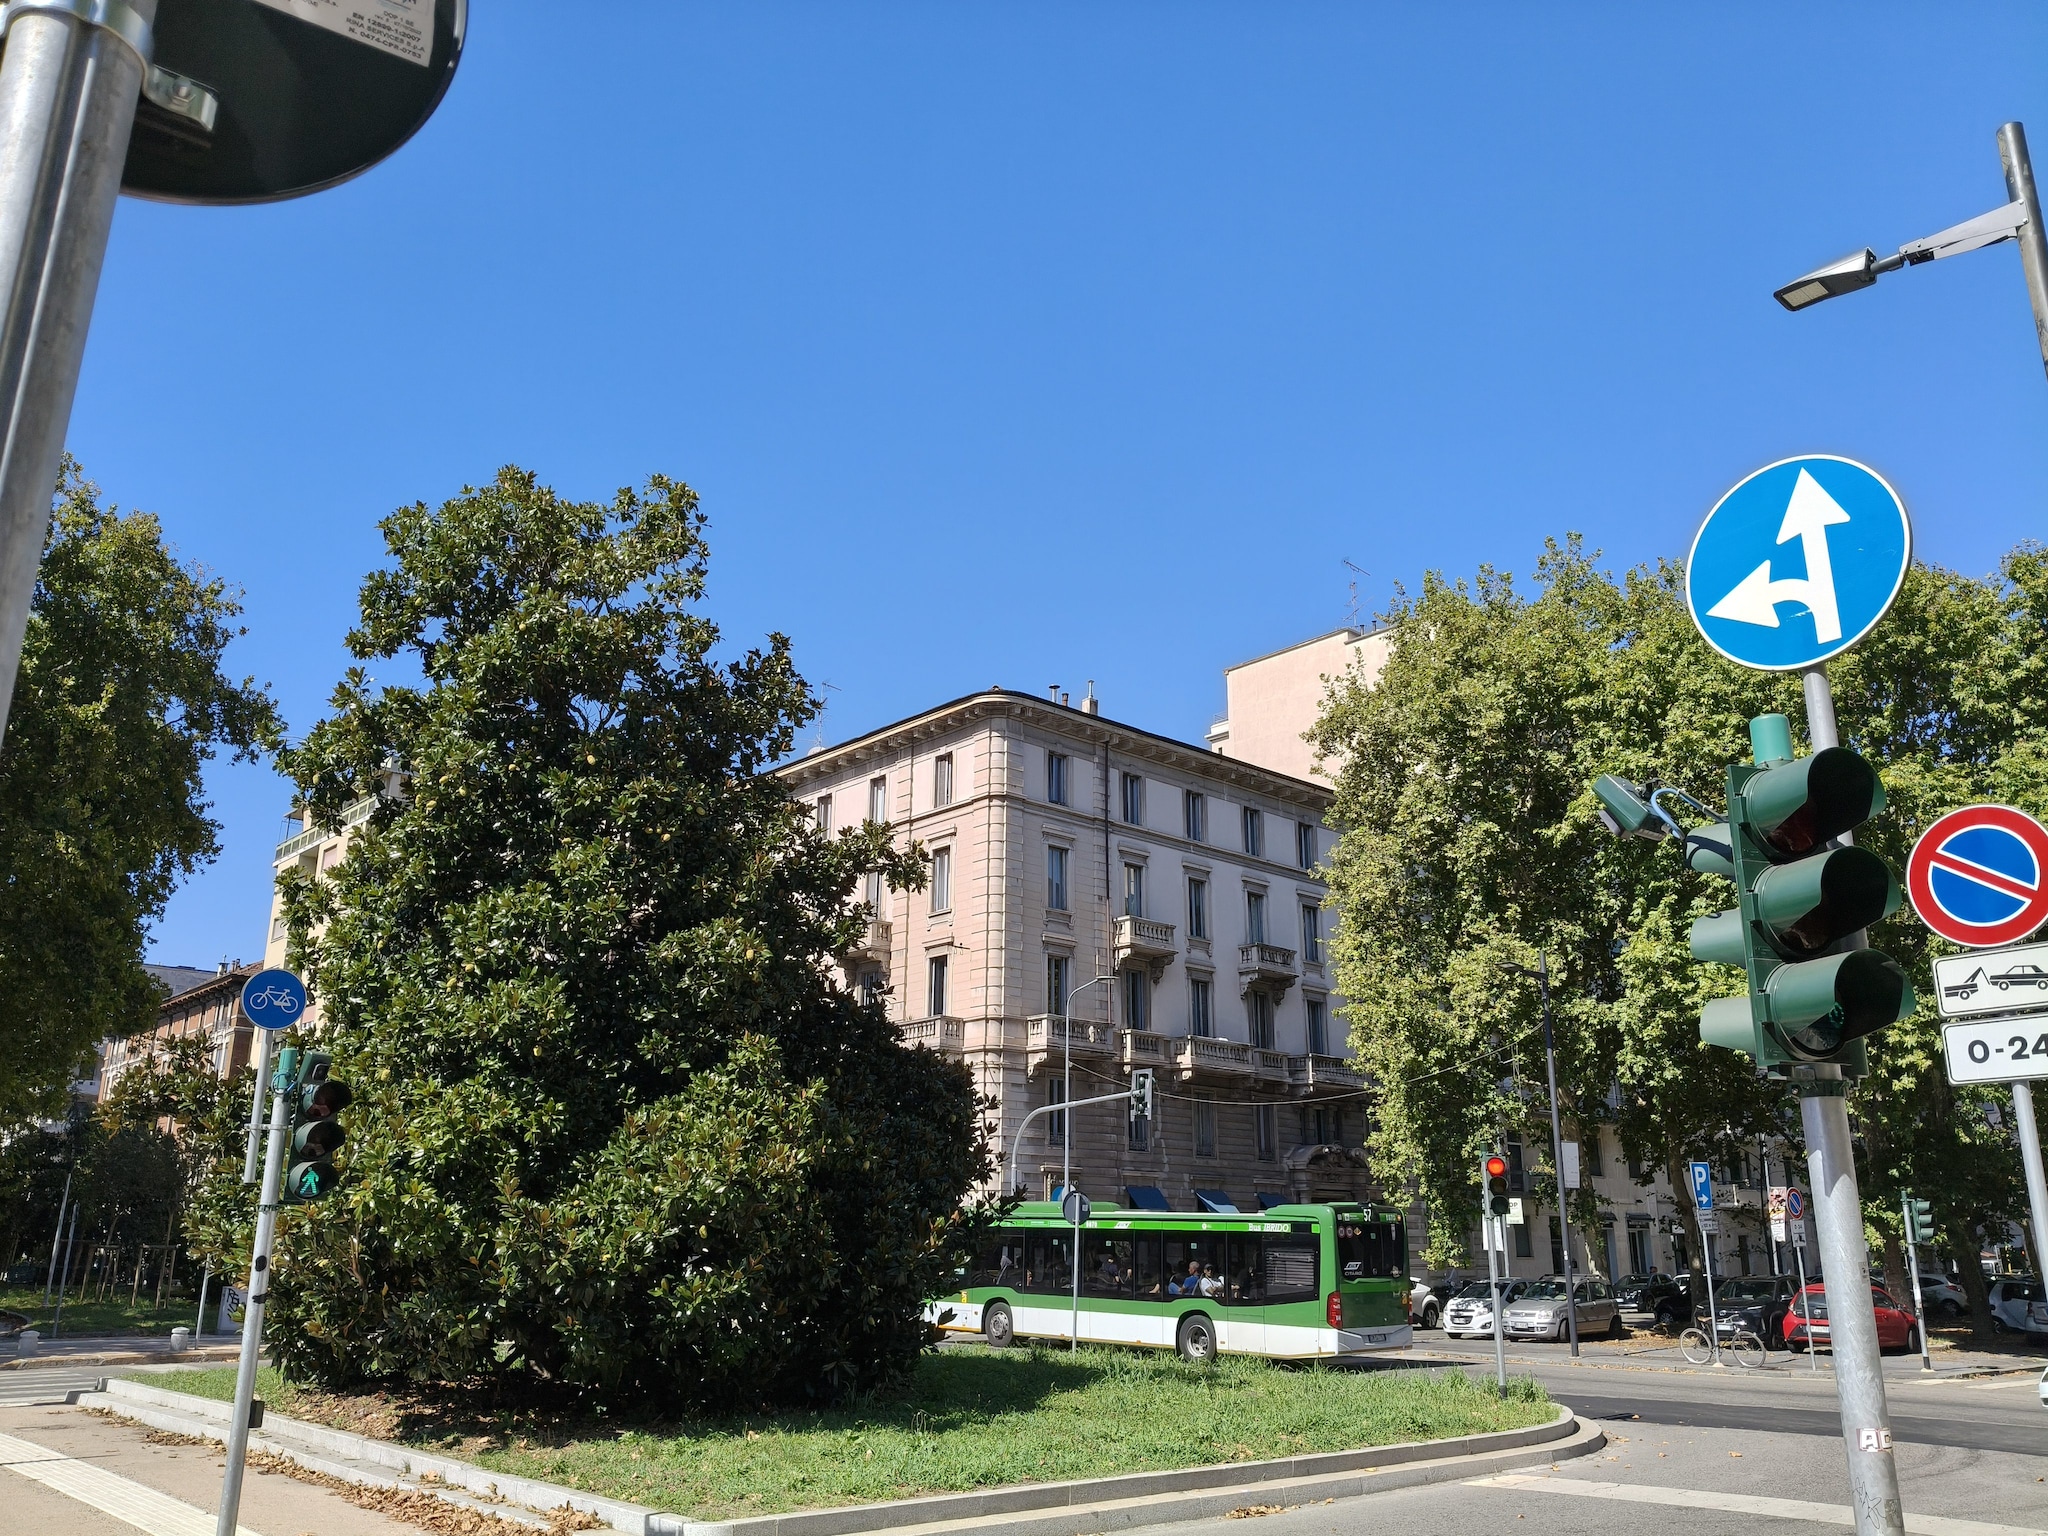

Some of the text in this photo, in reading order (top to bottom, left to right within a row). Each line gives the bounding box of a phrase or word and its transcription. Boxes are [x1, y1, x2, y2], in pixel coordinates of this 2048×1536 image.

[367, 26, 404, 44] SERVICES
[1694, 1166, 1707, 1191] P
[1363, 1208, 1372, 1222] 57
[1248, 1223, 1290, 1232] Bus IBRIDO
